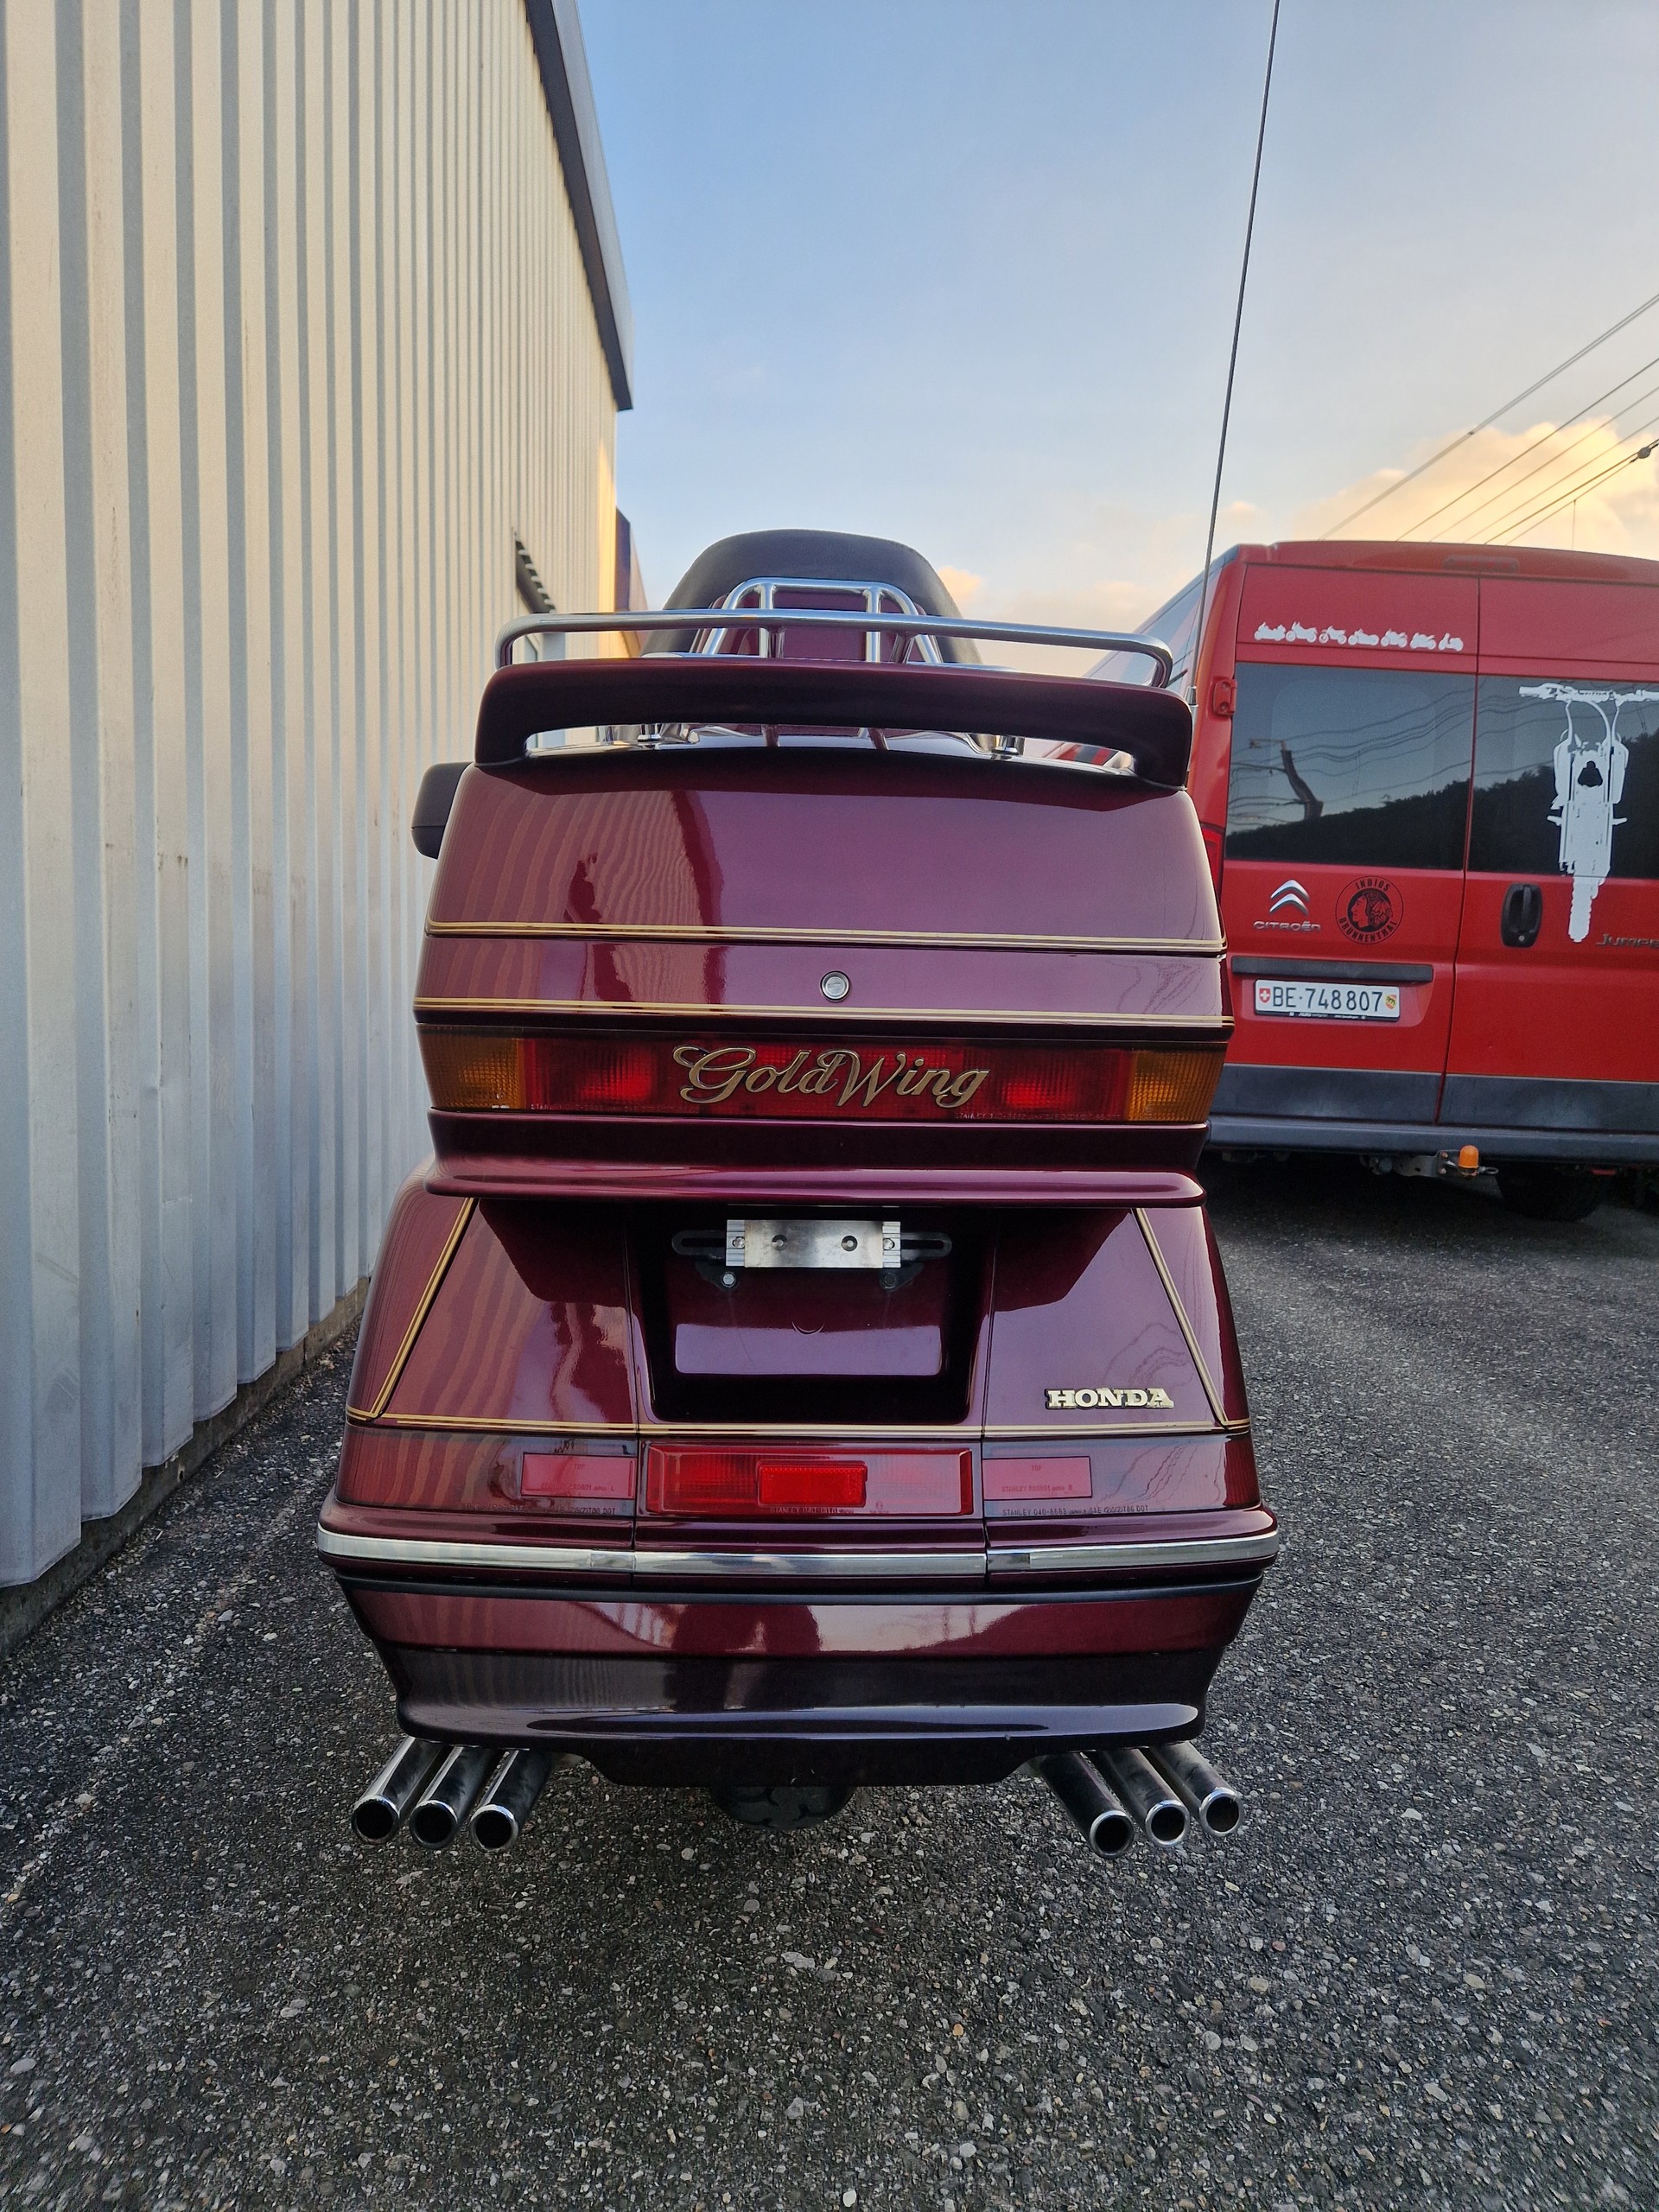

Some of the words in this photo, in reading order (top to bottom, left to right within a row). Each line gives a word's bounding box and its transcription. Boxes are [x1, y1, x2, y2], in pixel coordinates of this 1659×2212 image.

[1355, 878, 1390, 892] INDIOS
[1339, 916, 1398, 943] BRUNNENTHAL
[1045, 1388, 1174, 1409] HONDA
